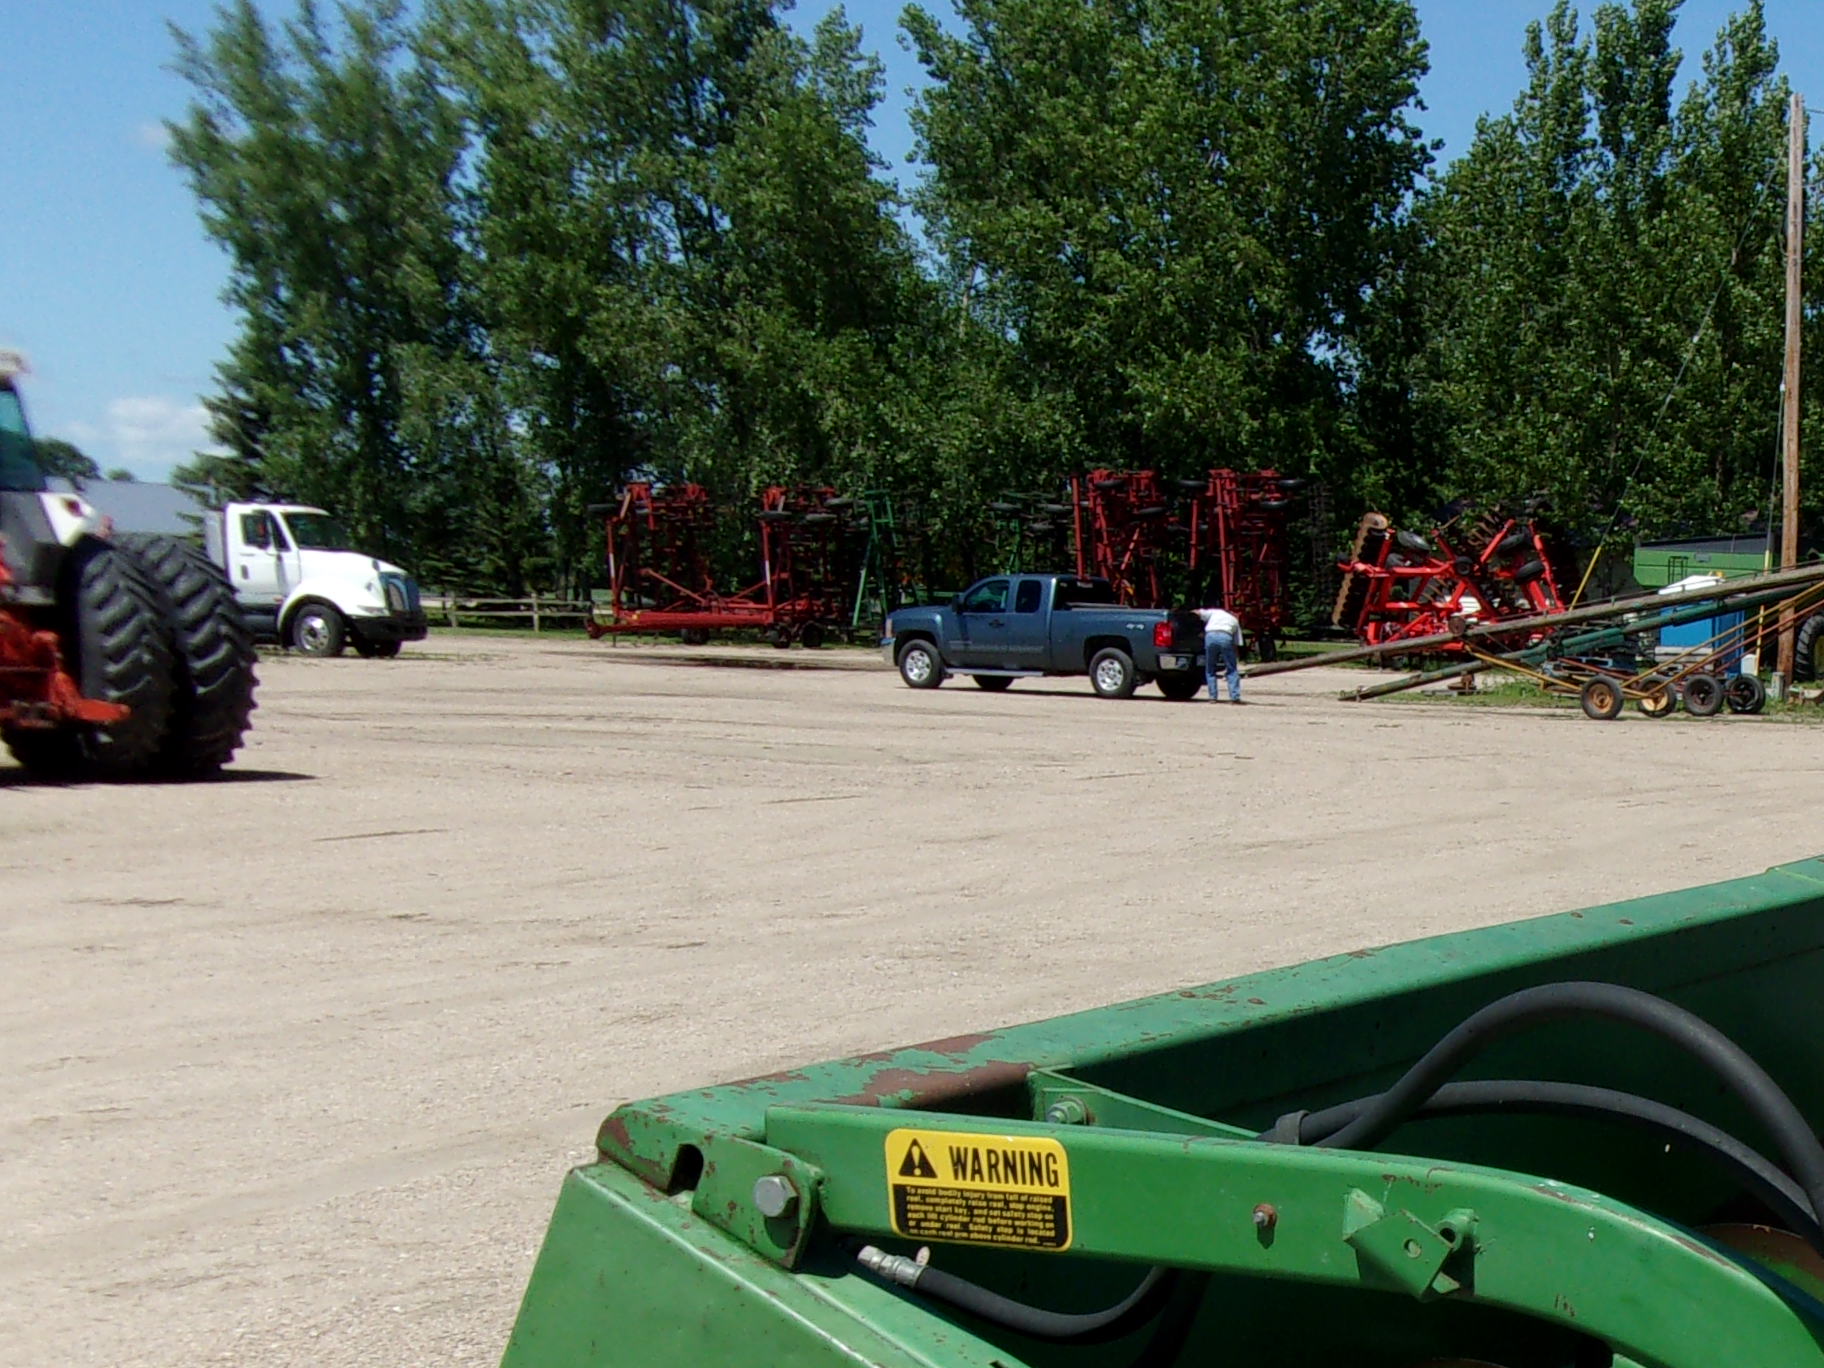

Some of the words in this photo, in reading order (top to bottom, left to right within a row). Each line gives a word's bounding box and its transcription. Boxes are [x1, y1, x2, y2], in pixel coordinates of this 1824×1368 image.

[949, 1145, 1060, 1188] WARNING
[906, 1186, 916, 1194] To
[917, 1187, 937, 1195] avoid
[1029, 1196, 1053, 1204] raised
[925, 1197, 966, 1206] completely
[940, 1214, 970, 1223] cylinder
[987, 1216, 1012, 1225] before
[1002, 1210, 1025, 1219] safety
[969, 1223, 993, 1233] Safety
[1027, 1228, 1055, 1237] located
[993, 1234, 1024, 1242] cylinder
